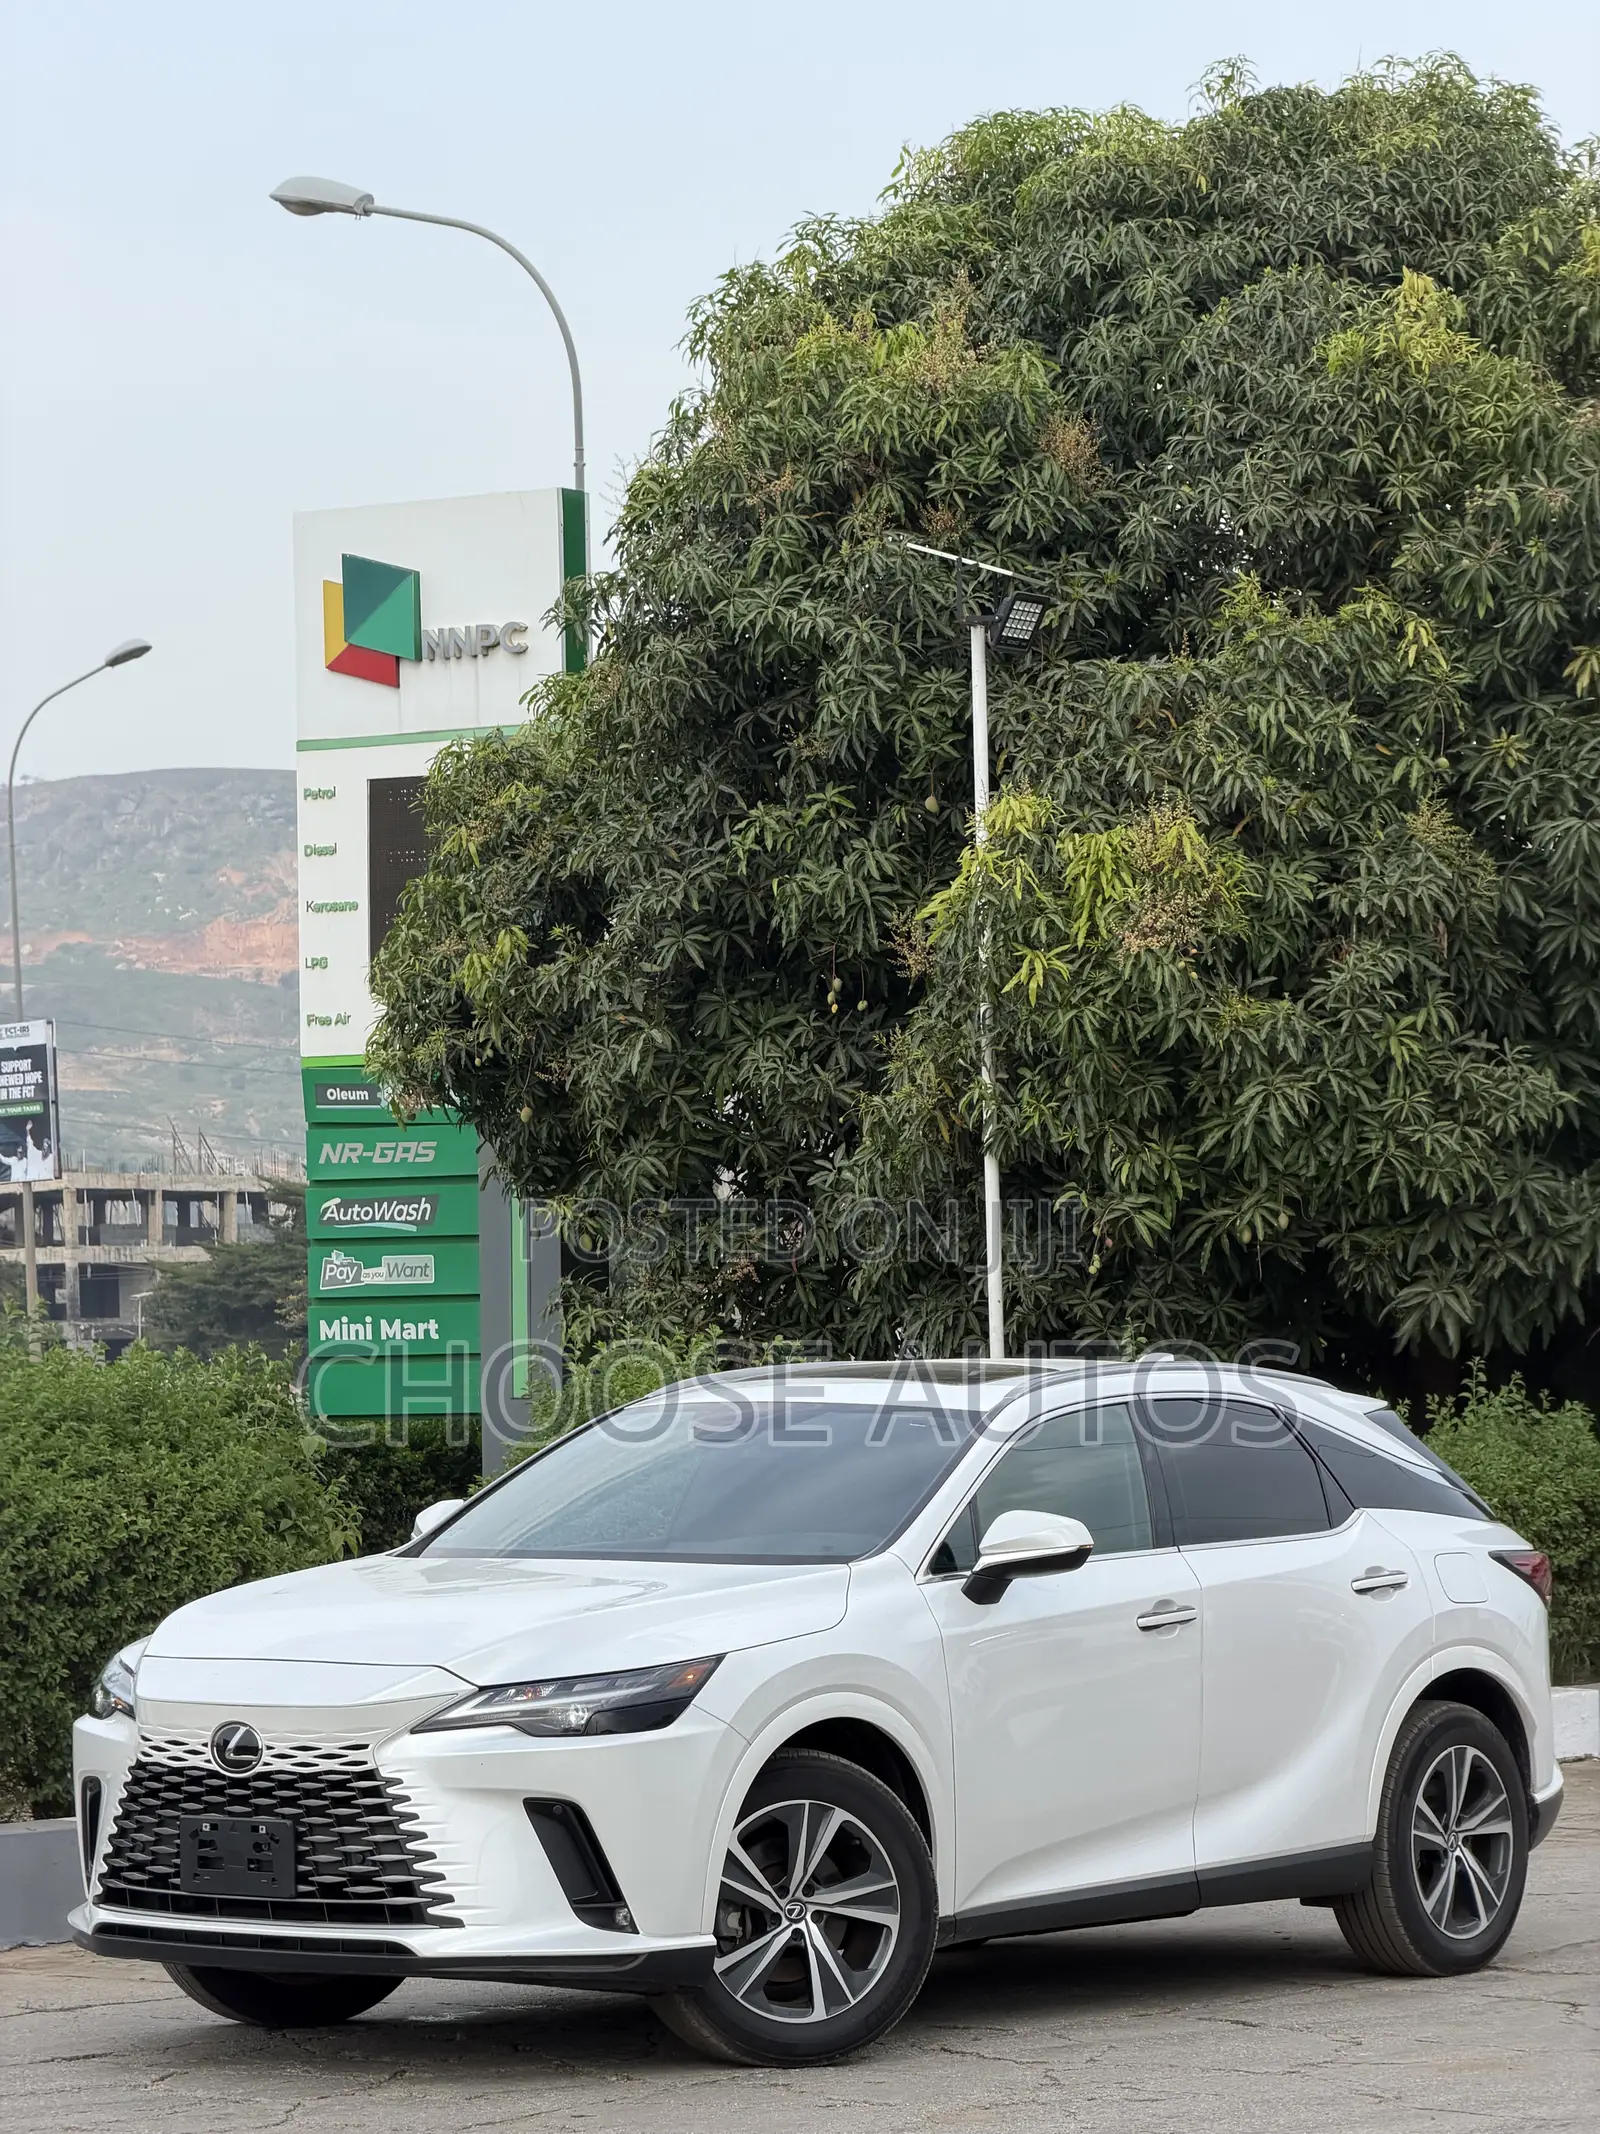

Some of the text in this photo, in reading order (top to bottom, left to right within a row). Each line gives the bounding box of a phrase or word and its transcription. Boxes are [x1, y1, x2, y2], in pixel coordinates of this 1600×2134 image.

[422, 621, 529, 662] NNPC
[303, 786, 336, 801] Petrol
[304, 843, 337, 857] Diesel
[306, 900, 358, 914] Kerosene
[305, 957, 328, 970] LPG
[306, 1012, 351, 1027] Free Air
[1, 1059, 32, 1073] SUPPORT
[24, 1072, 43, 1085] HOPE
[9, 1086, 21, 1100] THE
[22, 1085, 35, 1098] FCT
[326, 1087, 369, 1101] Oleum
[319, 1141, 437, 1164] NR-GAS
[320, 1197, 431, 1221] AutoWash
[325, 1262, 430, 1283] Pay as you Want
[319, 1316, 440, 1341] Mini Mart
